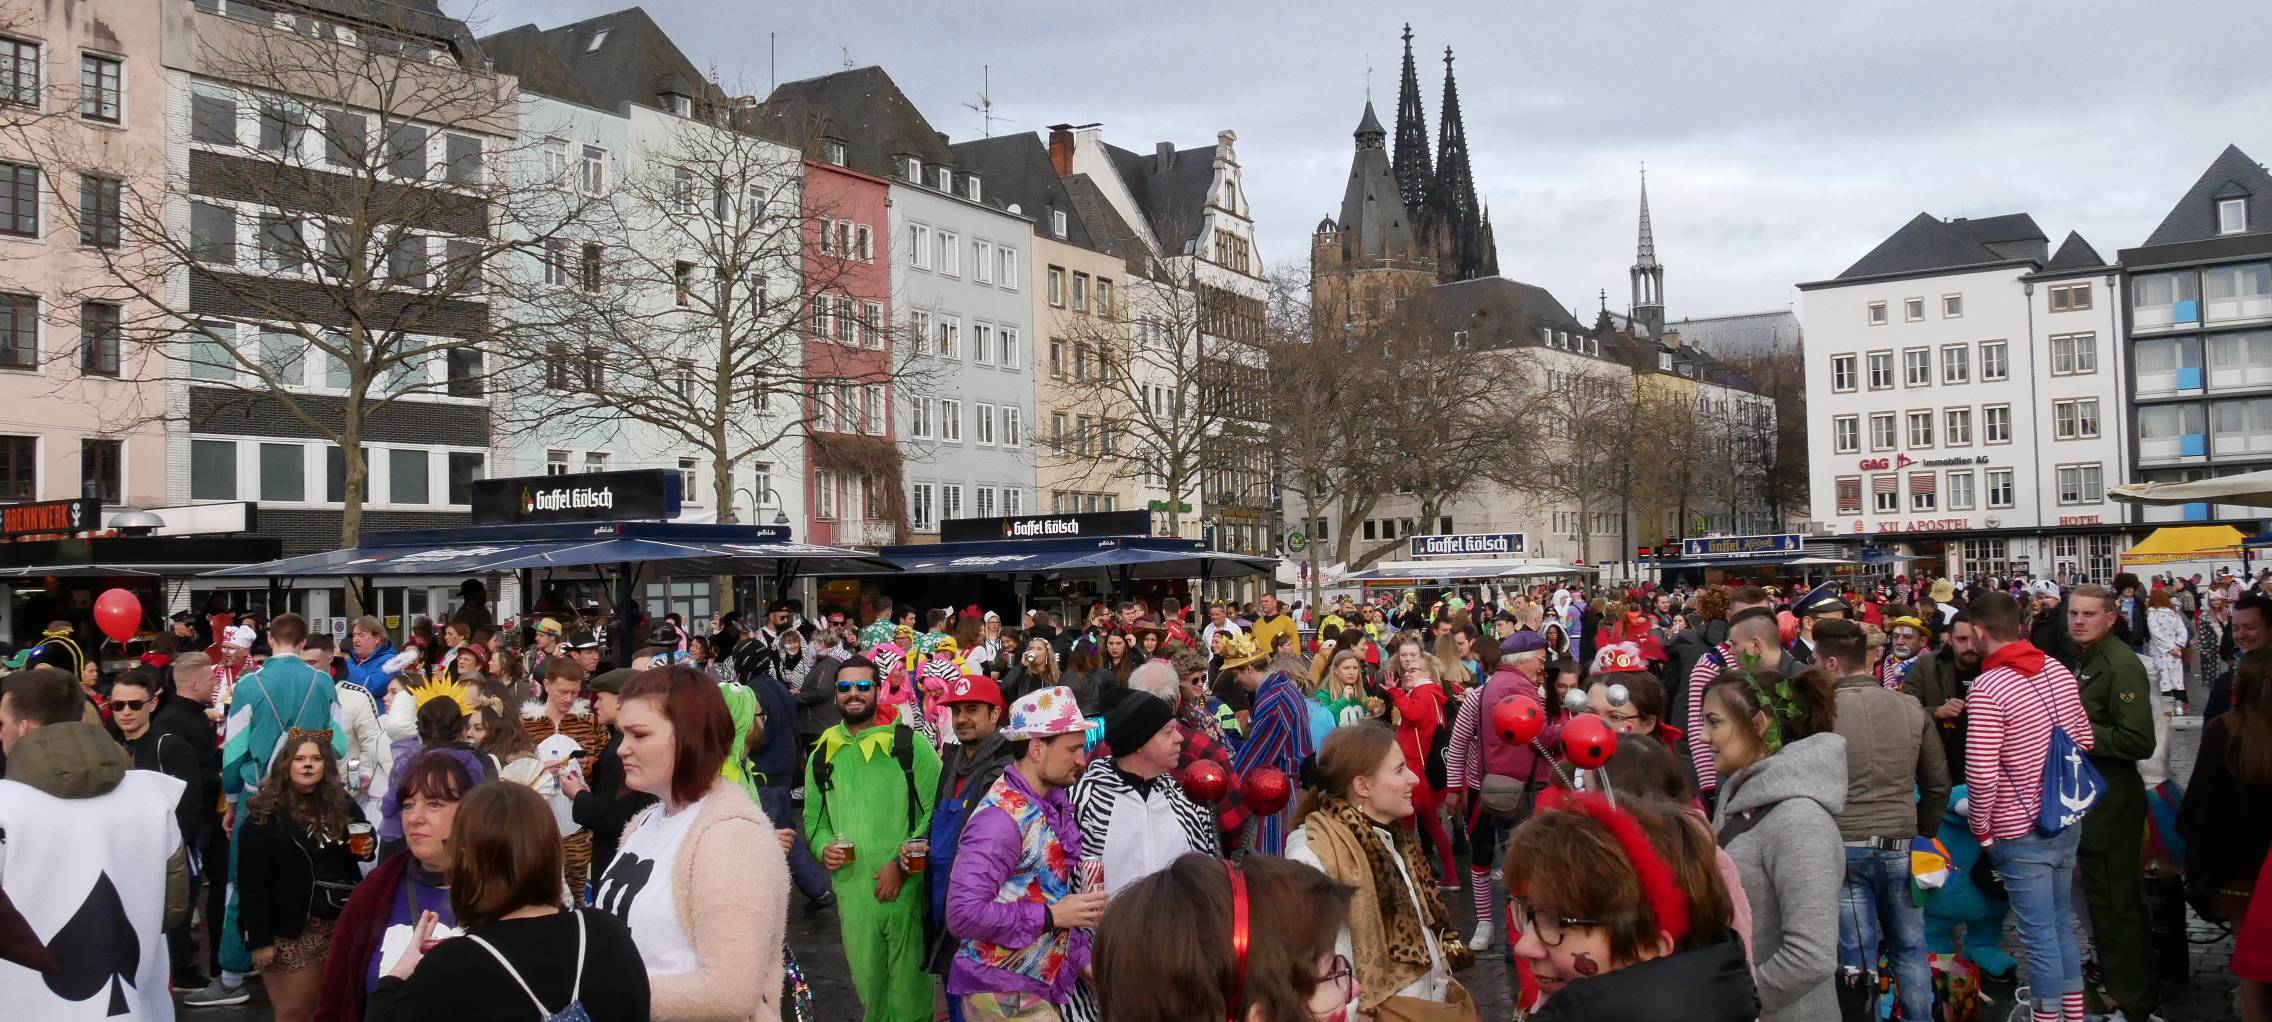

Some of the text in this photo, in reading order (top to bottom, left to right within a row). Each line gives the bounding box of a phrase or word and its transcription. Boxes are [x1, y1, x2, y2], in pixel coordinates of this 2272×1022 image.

[1860, 458, 1889, 471] GAG
[1975, 455, 1989, 465] AG
[536, 486, 613, 511] Gaffel Kölsch
[4, 503, 69, 533] BRENNWERK
[1877, 518, 1972, 534] XII APOSTEL
[2059, 515, 2103, 528] HOTEL
[1014, 518, 1079, 536] Gaffel Kölsch
[1426, 535, 1508, 554] Gaffel Kölsch
[1708, 537, 1740, 552] Gaffel
